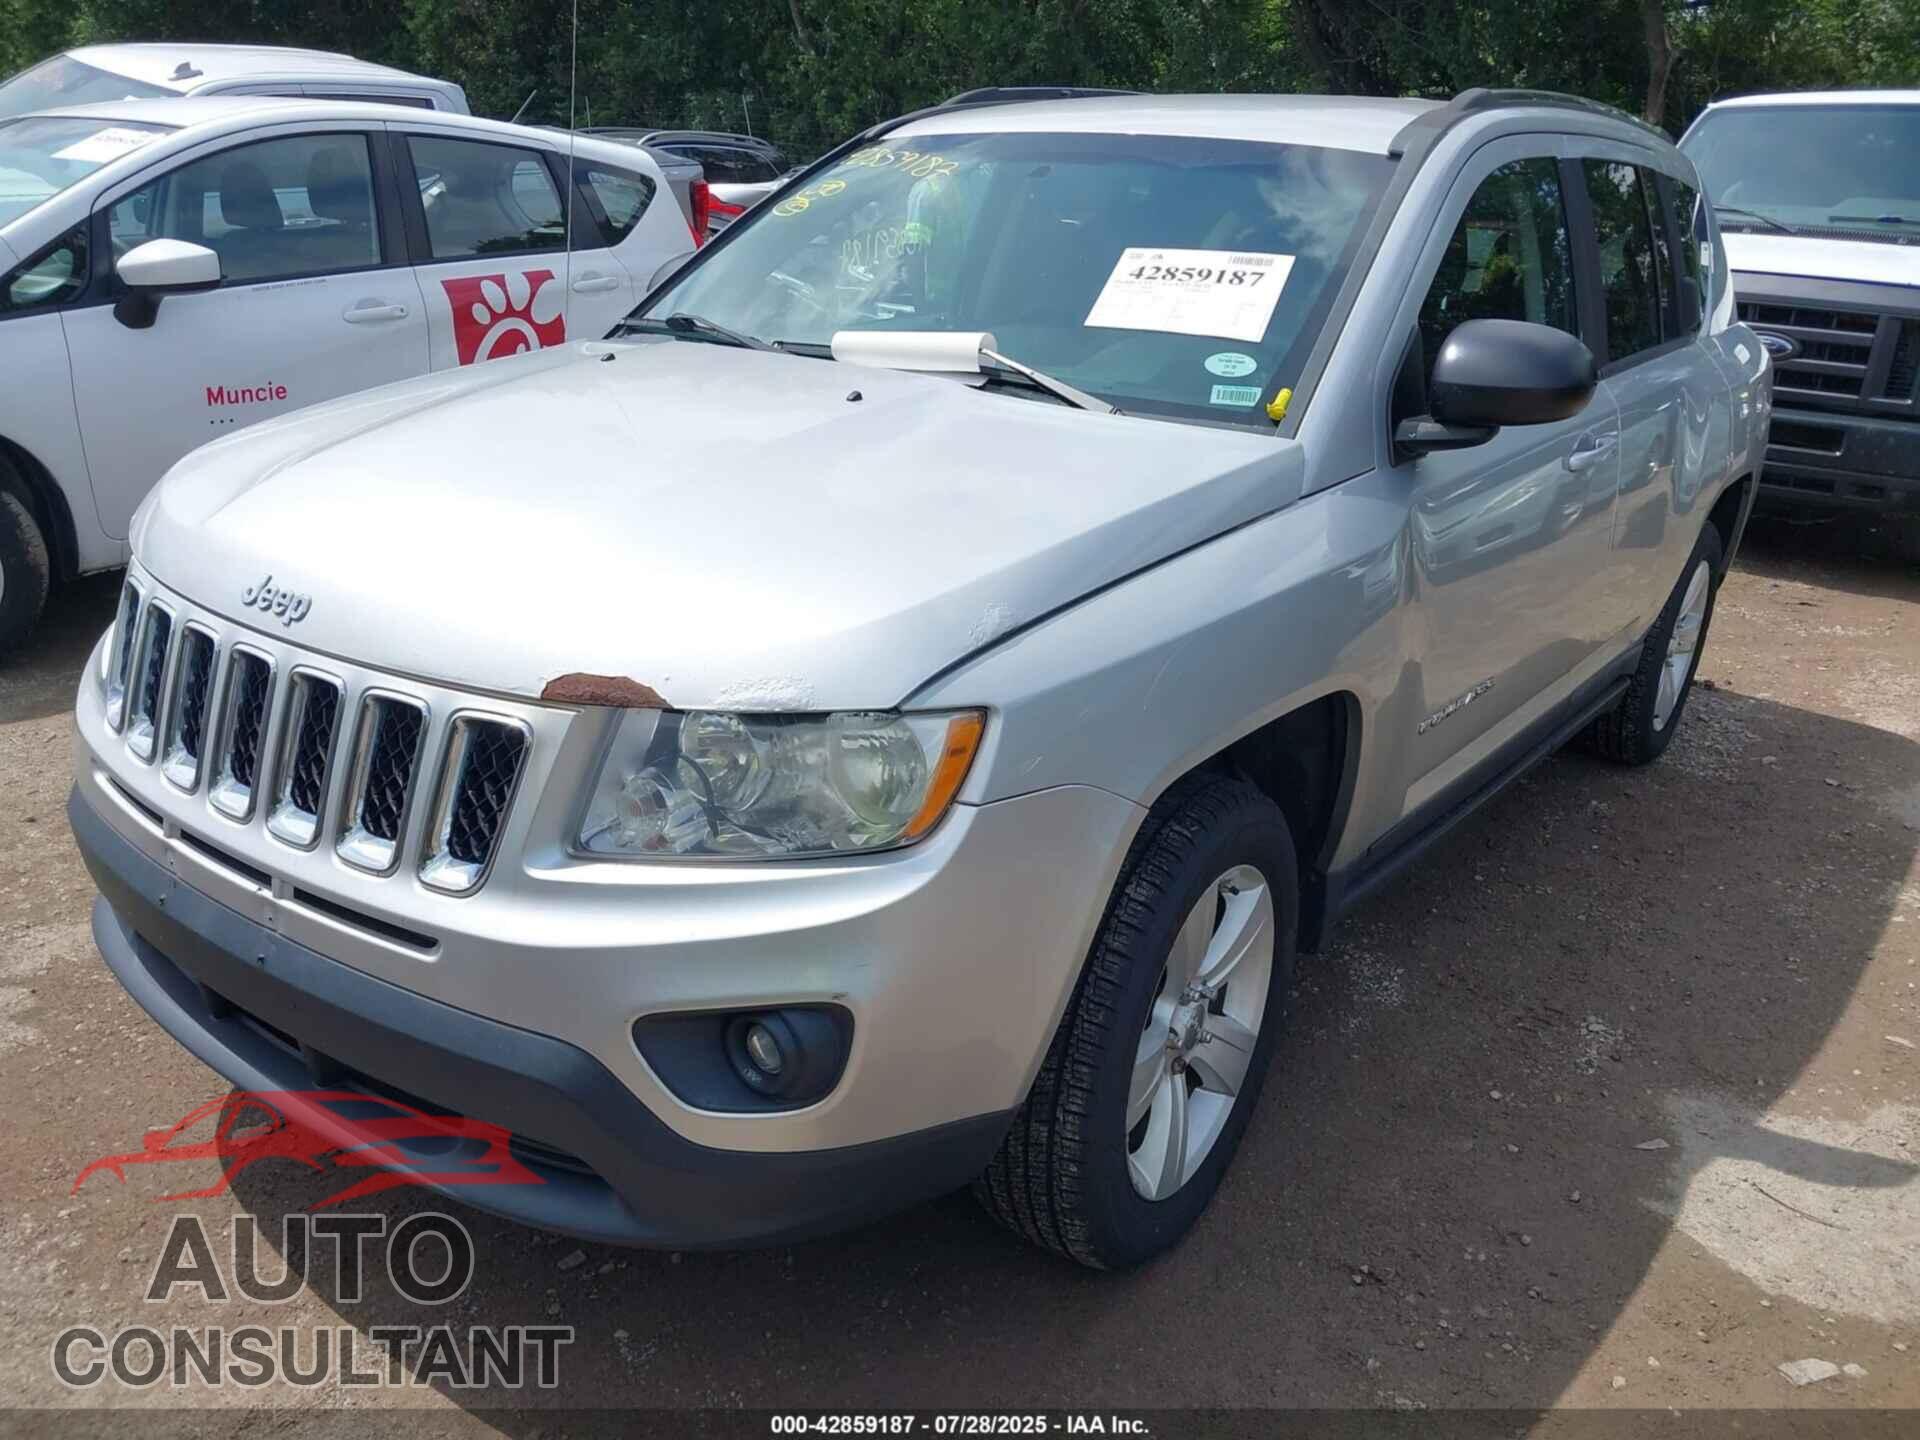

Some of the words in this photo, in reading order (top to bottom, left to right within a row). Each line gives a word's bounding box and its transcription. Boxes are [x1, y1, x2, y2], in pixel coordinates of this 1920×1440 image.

[1129, 265, 1265, 287] 42859187
[206, 380, 288, 407] Muncie
[242, 574, 312, 627] Jeep
